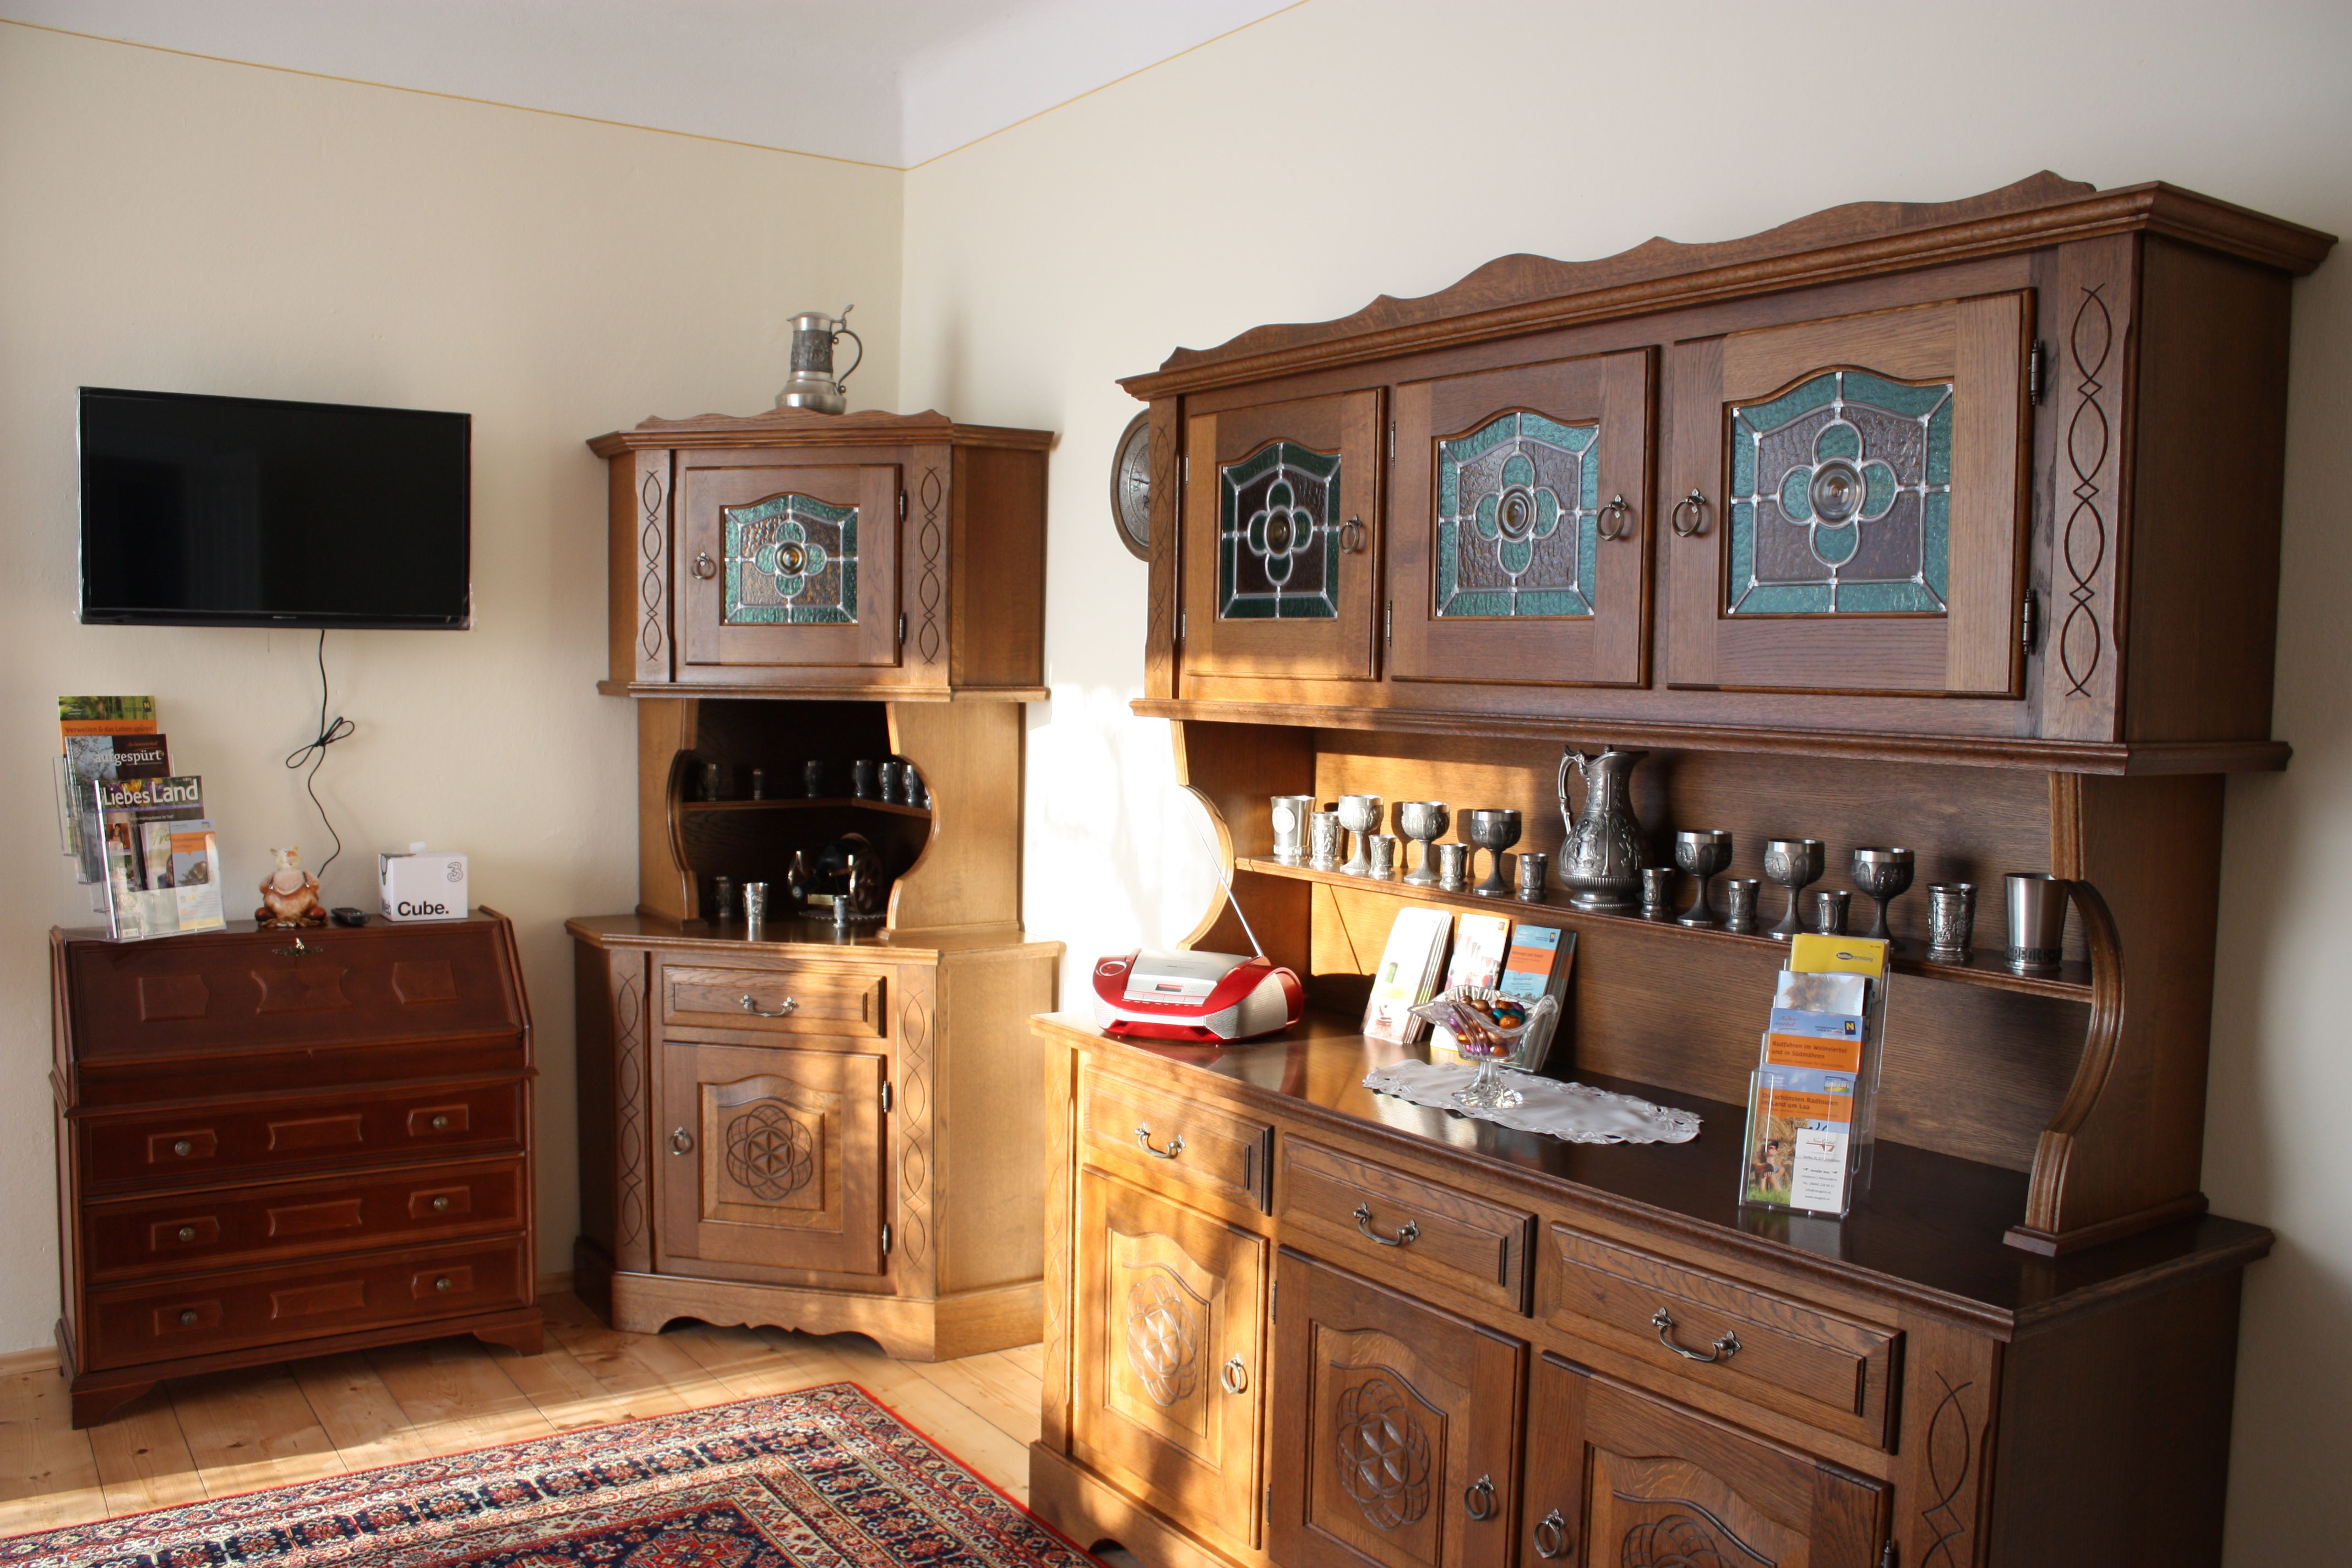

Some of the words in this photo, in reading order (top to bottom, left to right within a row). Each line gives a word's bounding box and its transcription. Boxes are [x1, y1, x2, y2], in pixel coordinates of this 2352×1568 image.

[133, 725, 153, 733] spüren
[94, 749, 162, 766] aufgespürt
[104, 786, 150, 806] Liebes
[151, 778, 199, 803] Land
[447, 862, 463, 882] 3
[381, 897, 391, 916] Web
[398, 900, 449, 916] Cube.
[1772, 1041, 1802, 1049] Radfahren
